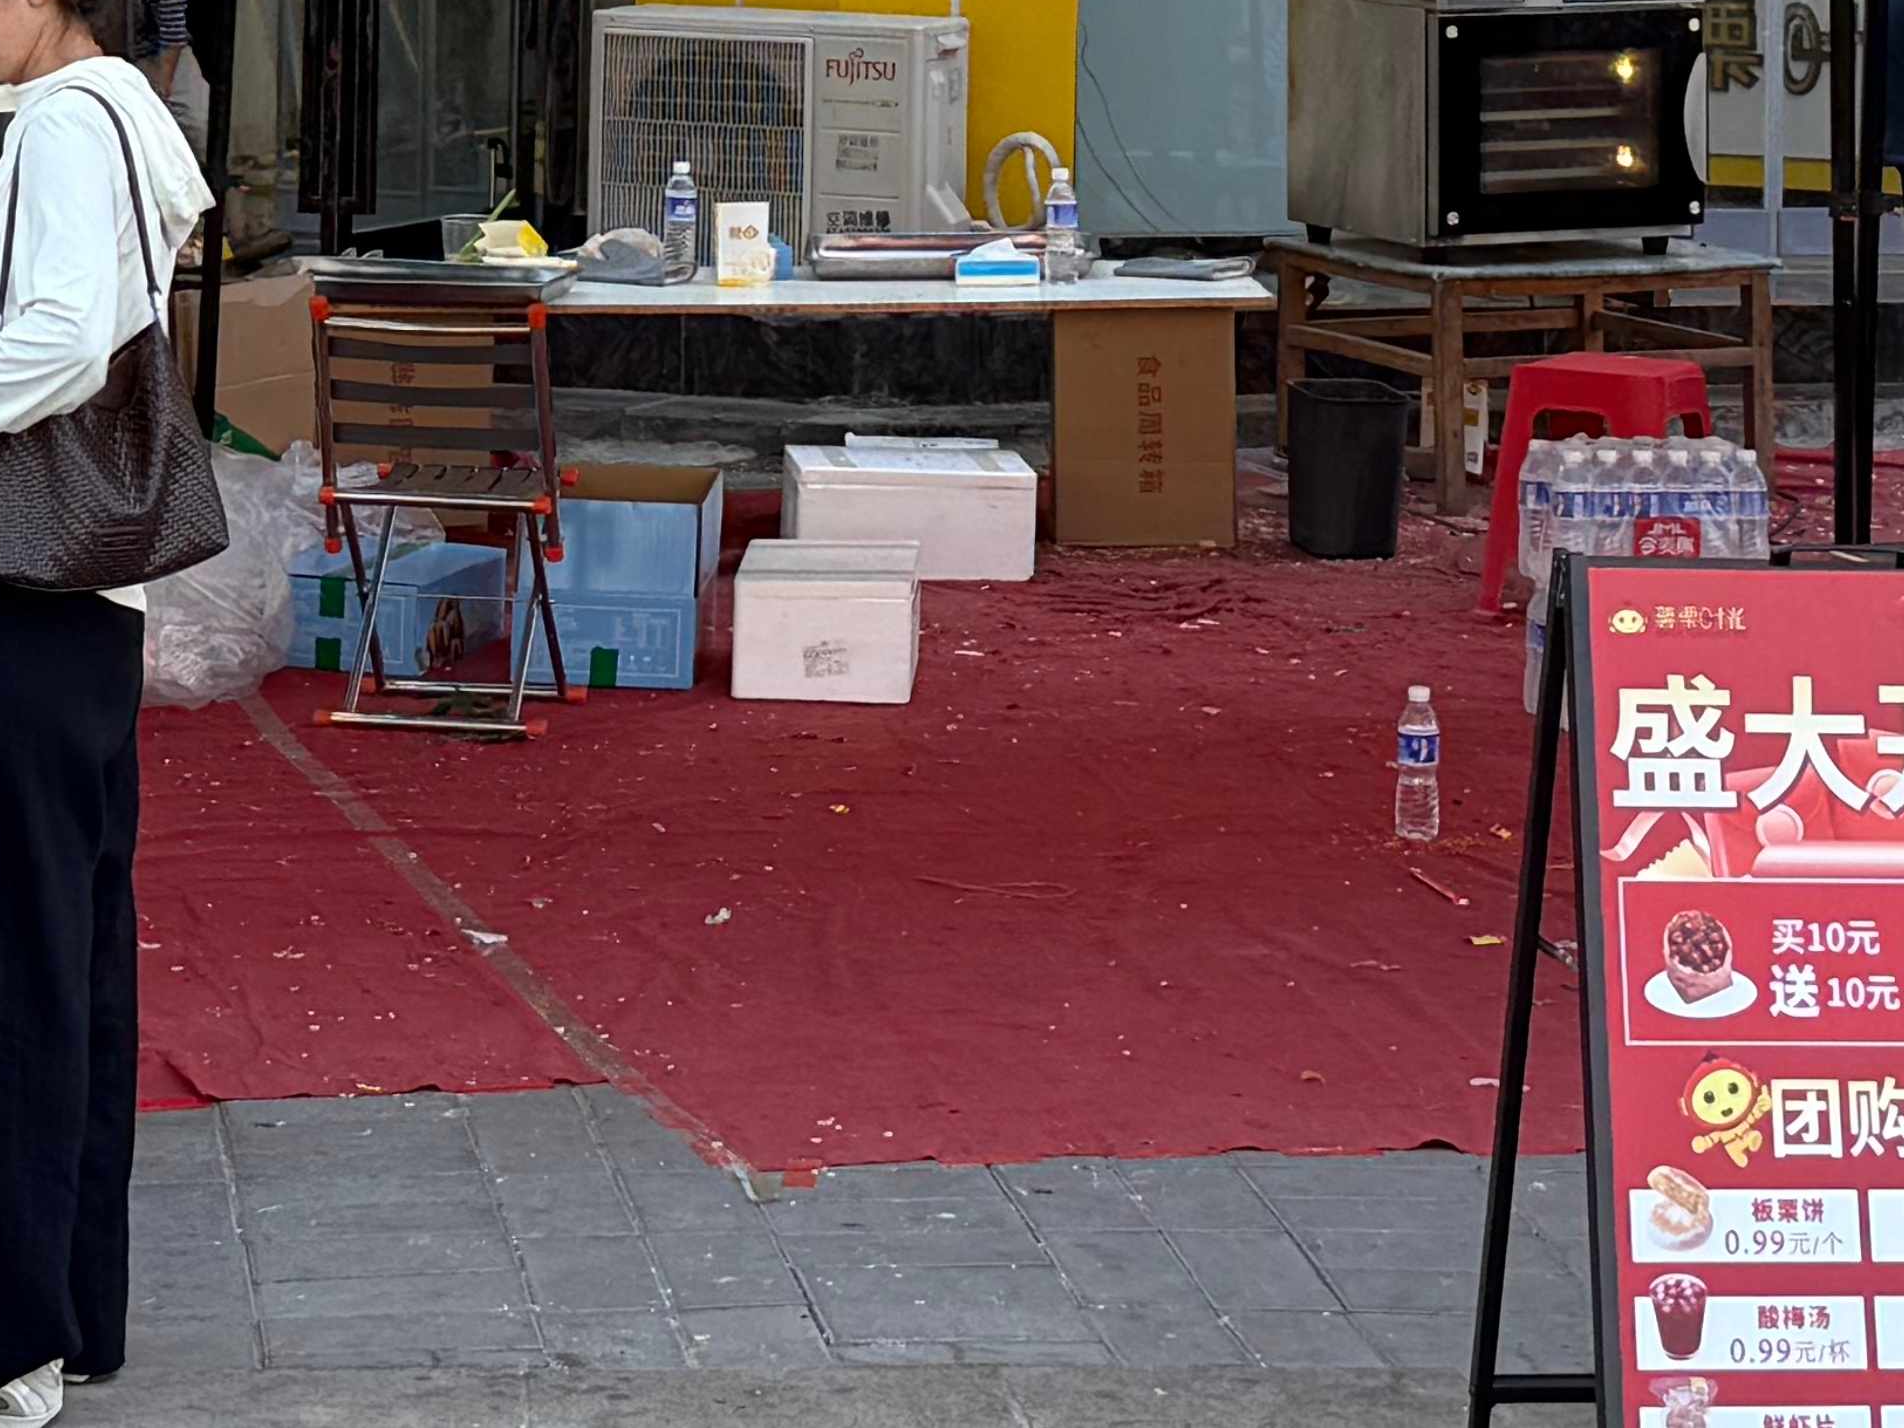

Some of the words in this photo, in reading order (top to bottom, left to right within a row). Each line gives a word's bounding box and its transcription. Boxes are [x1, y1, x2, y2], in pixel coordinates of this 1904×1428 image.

[825, 47, 897, 86] FUJITSU
[1771, 918, 1881, 957] 买10元
[1756, 1304, 1833, 1331] 酸梅汤
